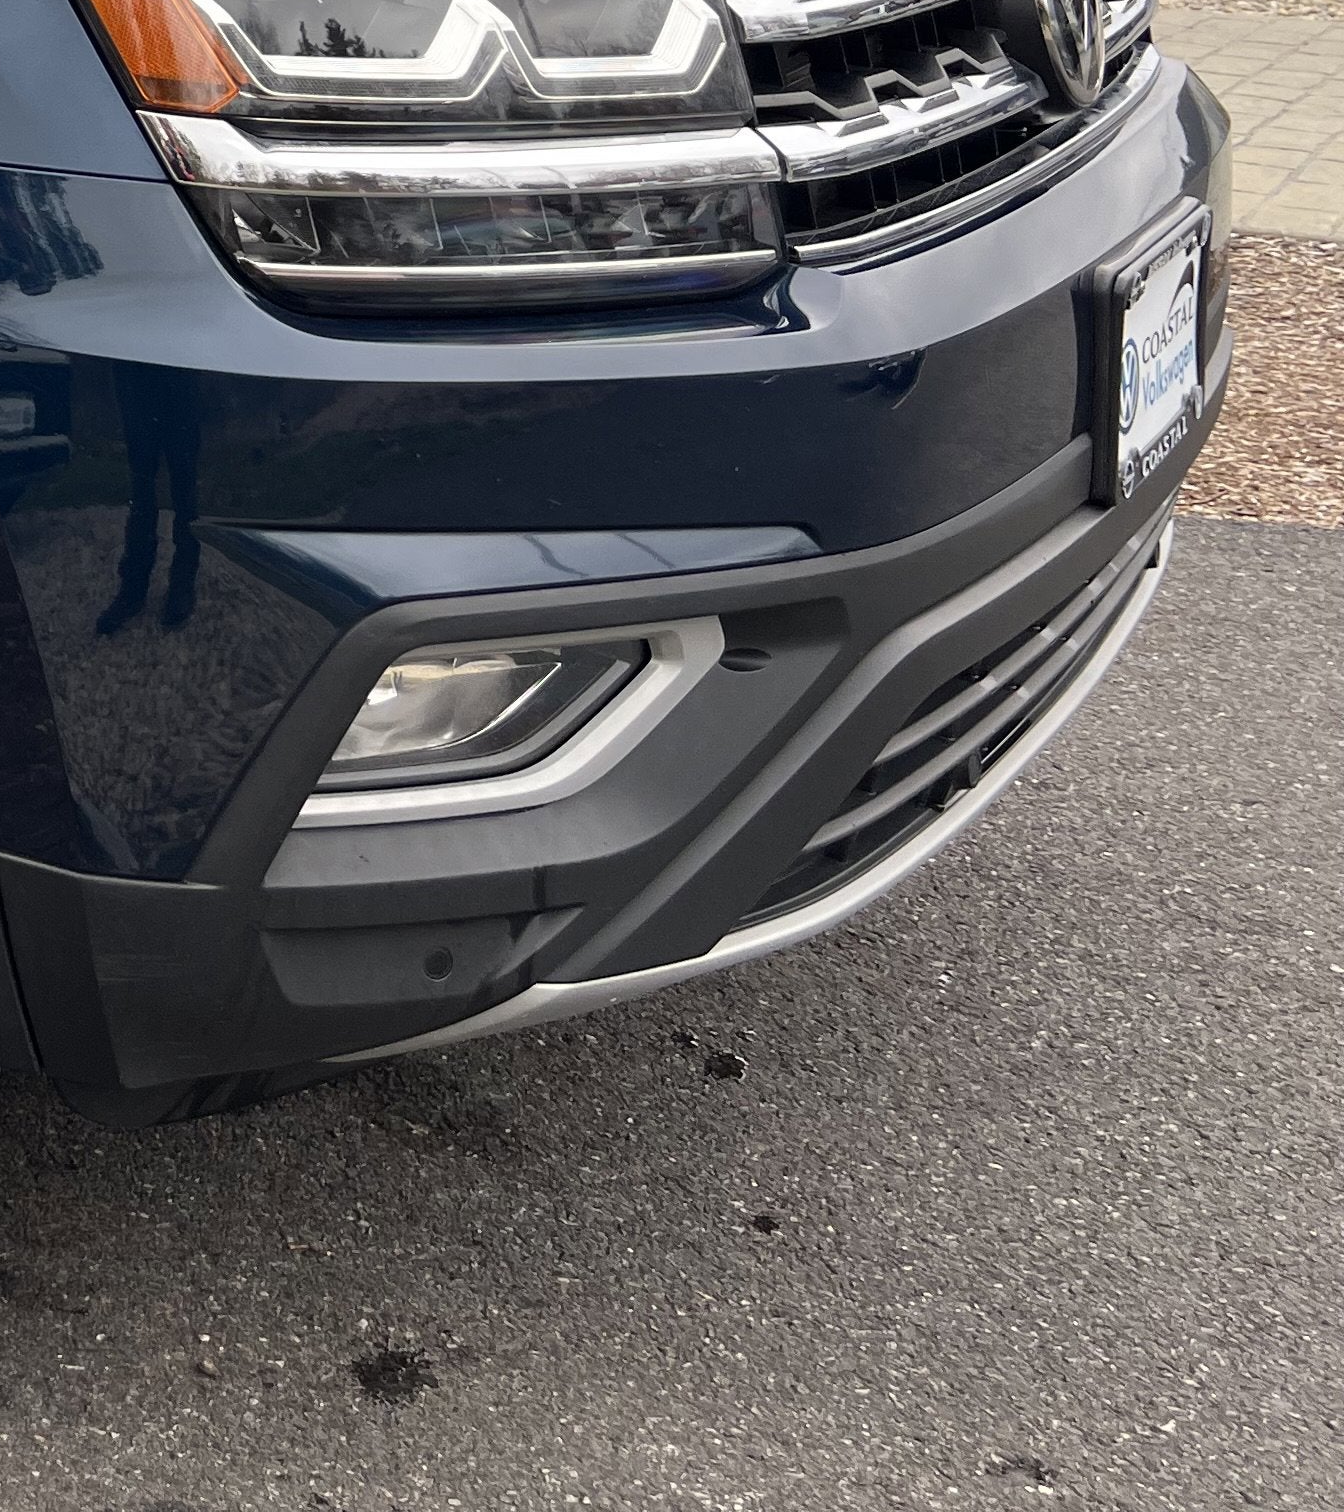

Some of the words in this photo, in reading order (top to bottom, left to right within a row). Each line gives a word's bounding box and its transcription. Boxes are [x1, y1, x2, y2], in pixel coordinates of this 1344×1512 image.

[1141, 295, 1194, 364] COASTAL
[1142, 339, 1194, 412] Volkswagen
[1141, 414, 1189, 478] COASTAL
